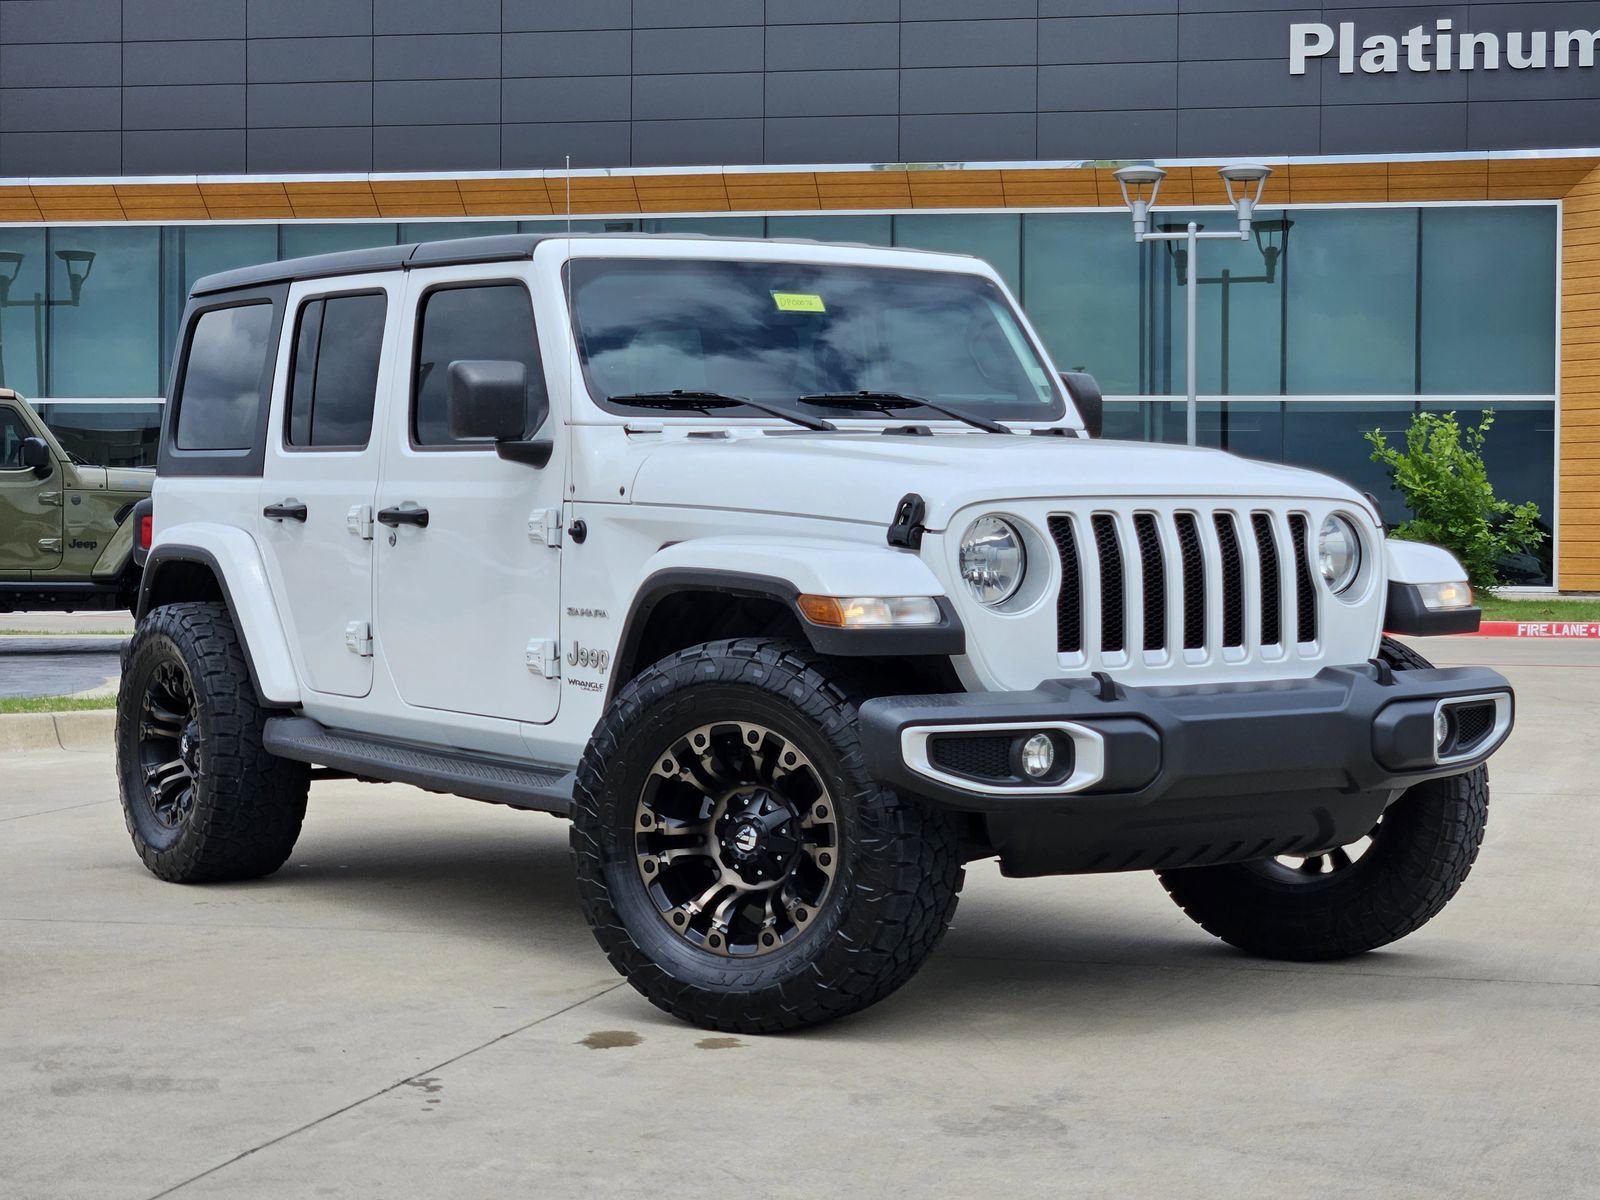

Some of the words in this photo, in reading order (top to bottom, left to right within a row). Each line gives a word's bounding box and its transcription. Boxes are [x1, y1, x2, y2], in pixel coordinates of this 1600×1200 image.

[1289, 19, 1600, 75] Platinum
[68, 538, 97, 551] Jeep
[1518, 624, 1548, 637] FIRE
[1552, 624, 1589, 637] LANE
[567, 640, 610, 675] Jeep
